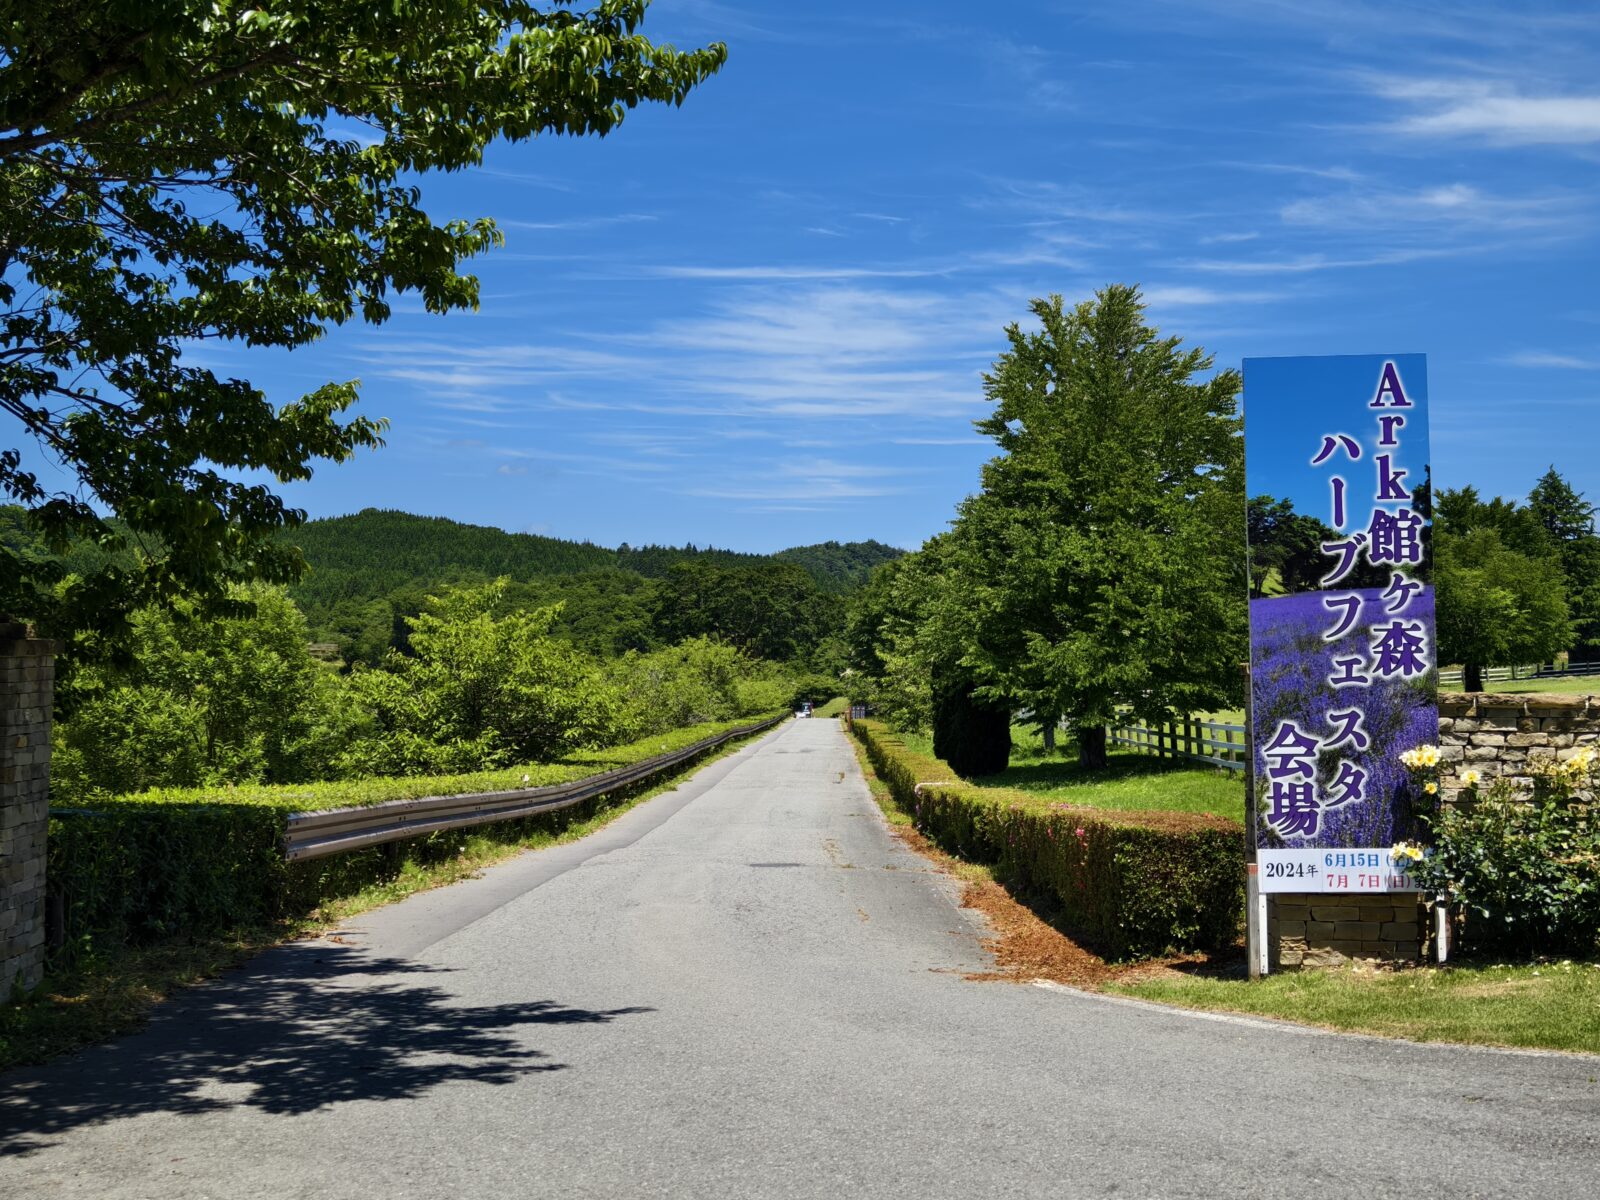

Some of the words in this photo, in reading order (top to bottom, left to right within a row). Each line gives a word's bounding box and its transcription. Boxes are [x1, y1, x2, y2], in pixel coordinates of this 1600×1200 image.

[1312, 434, 1369, 808] ハーブフェスタ
[1263, 722, 1321, 836] 会場
[1265, 862, 1319, 878] 2024年
